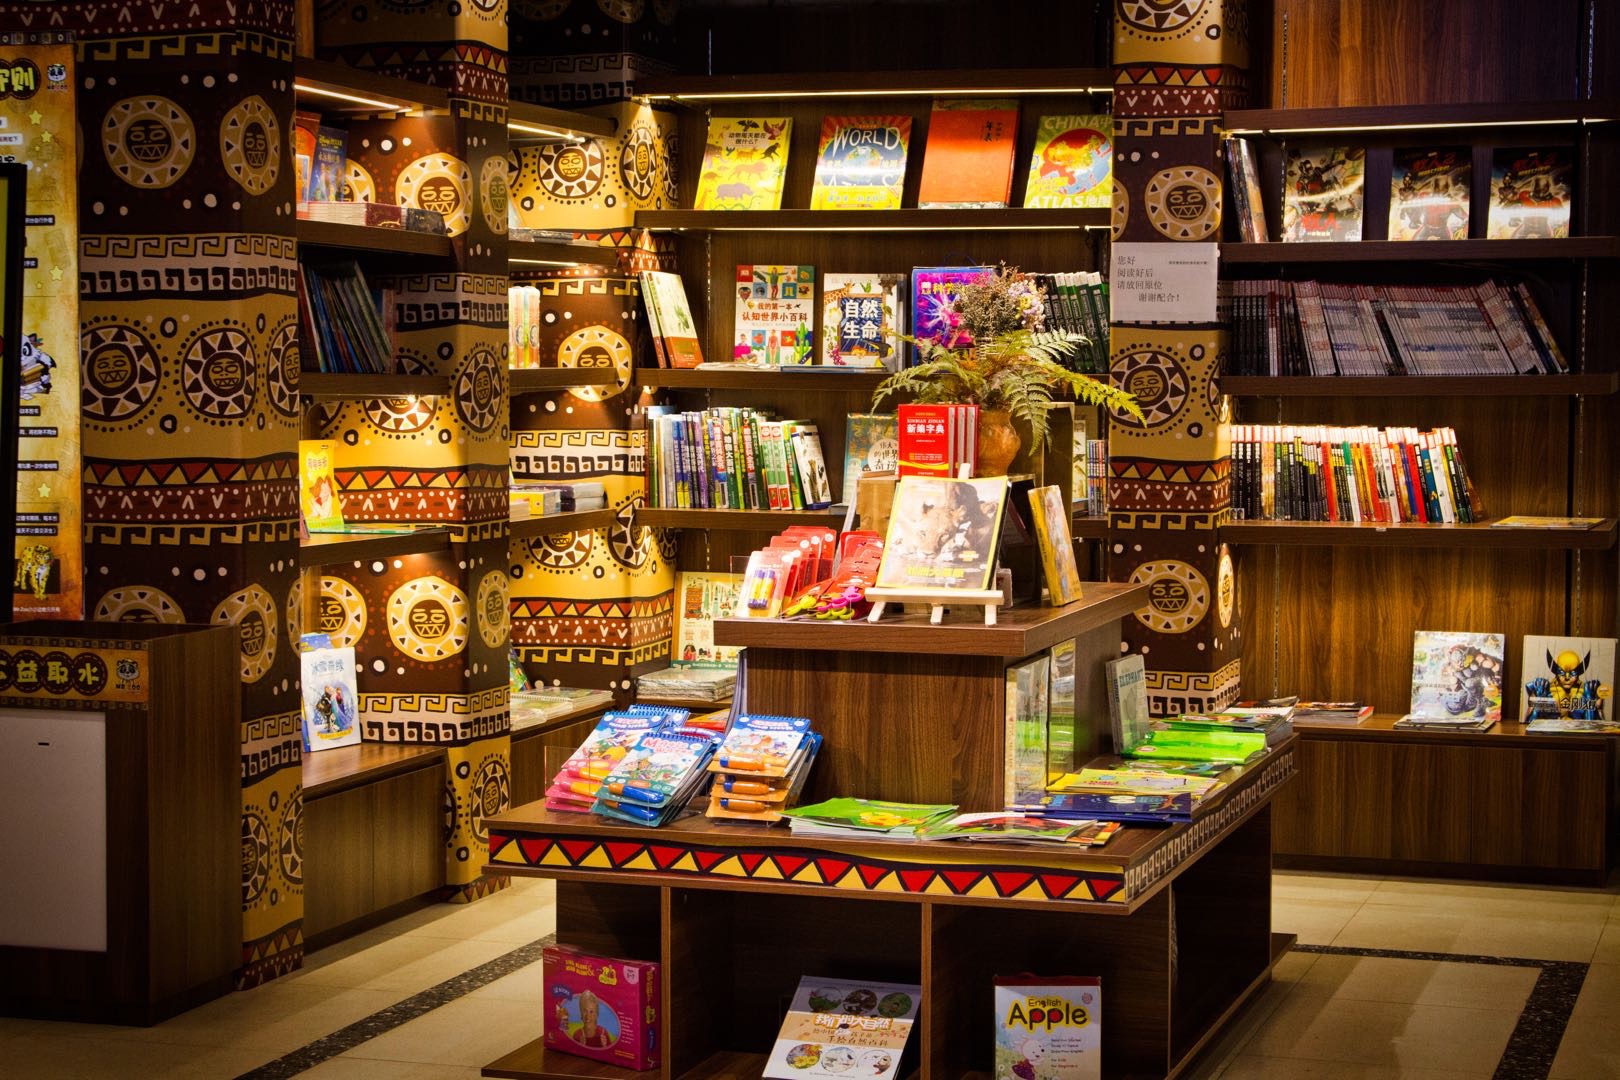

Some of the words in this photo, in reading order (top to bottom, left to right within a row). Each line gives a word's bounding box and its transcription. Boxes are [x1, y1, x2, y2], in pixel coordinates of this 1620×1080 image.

[1044, 116, 1099, 129] CHINA
[832, 125, 900, 157] WORLD
[1028, 195, 1083, 208] ATLAS
[1117, 256, 1135, 265] 您好
[1117, 268, 1153, 278] 阅读好后
[1117, 280, 1162, 290] 请放回原位
[1138, 293, 1180, 302] 谢谢配合！
[845, 299, 878, 318] 自然
[742, 312, 807, 322] 认知世界小百科
[843, 320, 879, 339] 生命
[907, 424, 945, 434] 新编字典
[1028, 999, 1061, 1008] English
[815, 1014, 889, 1030] 我们的大自然
[1008, 1003, 1087, 1030] Apple
